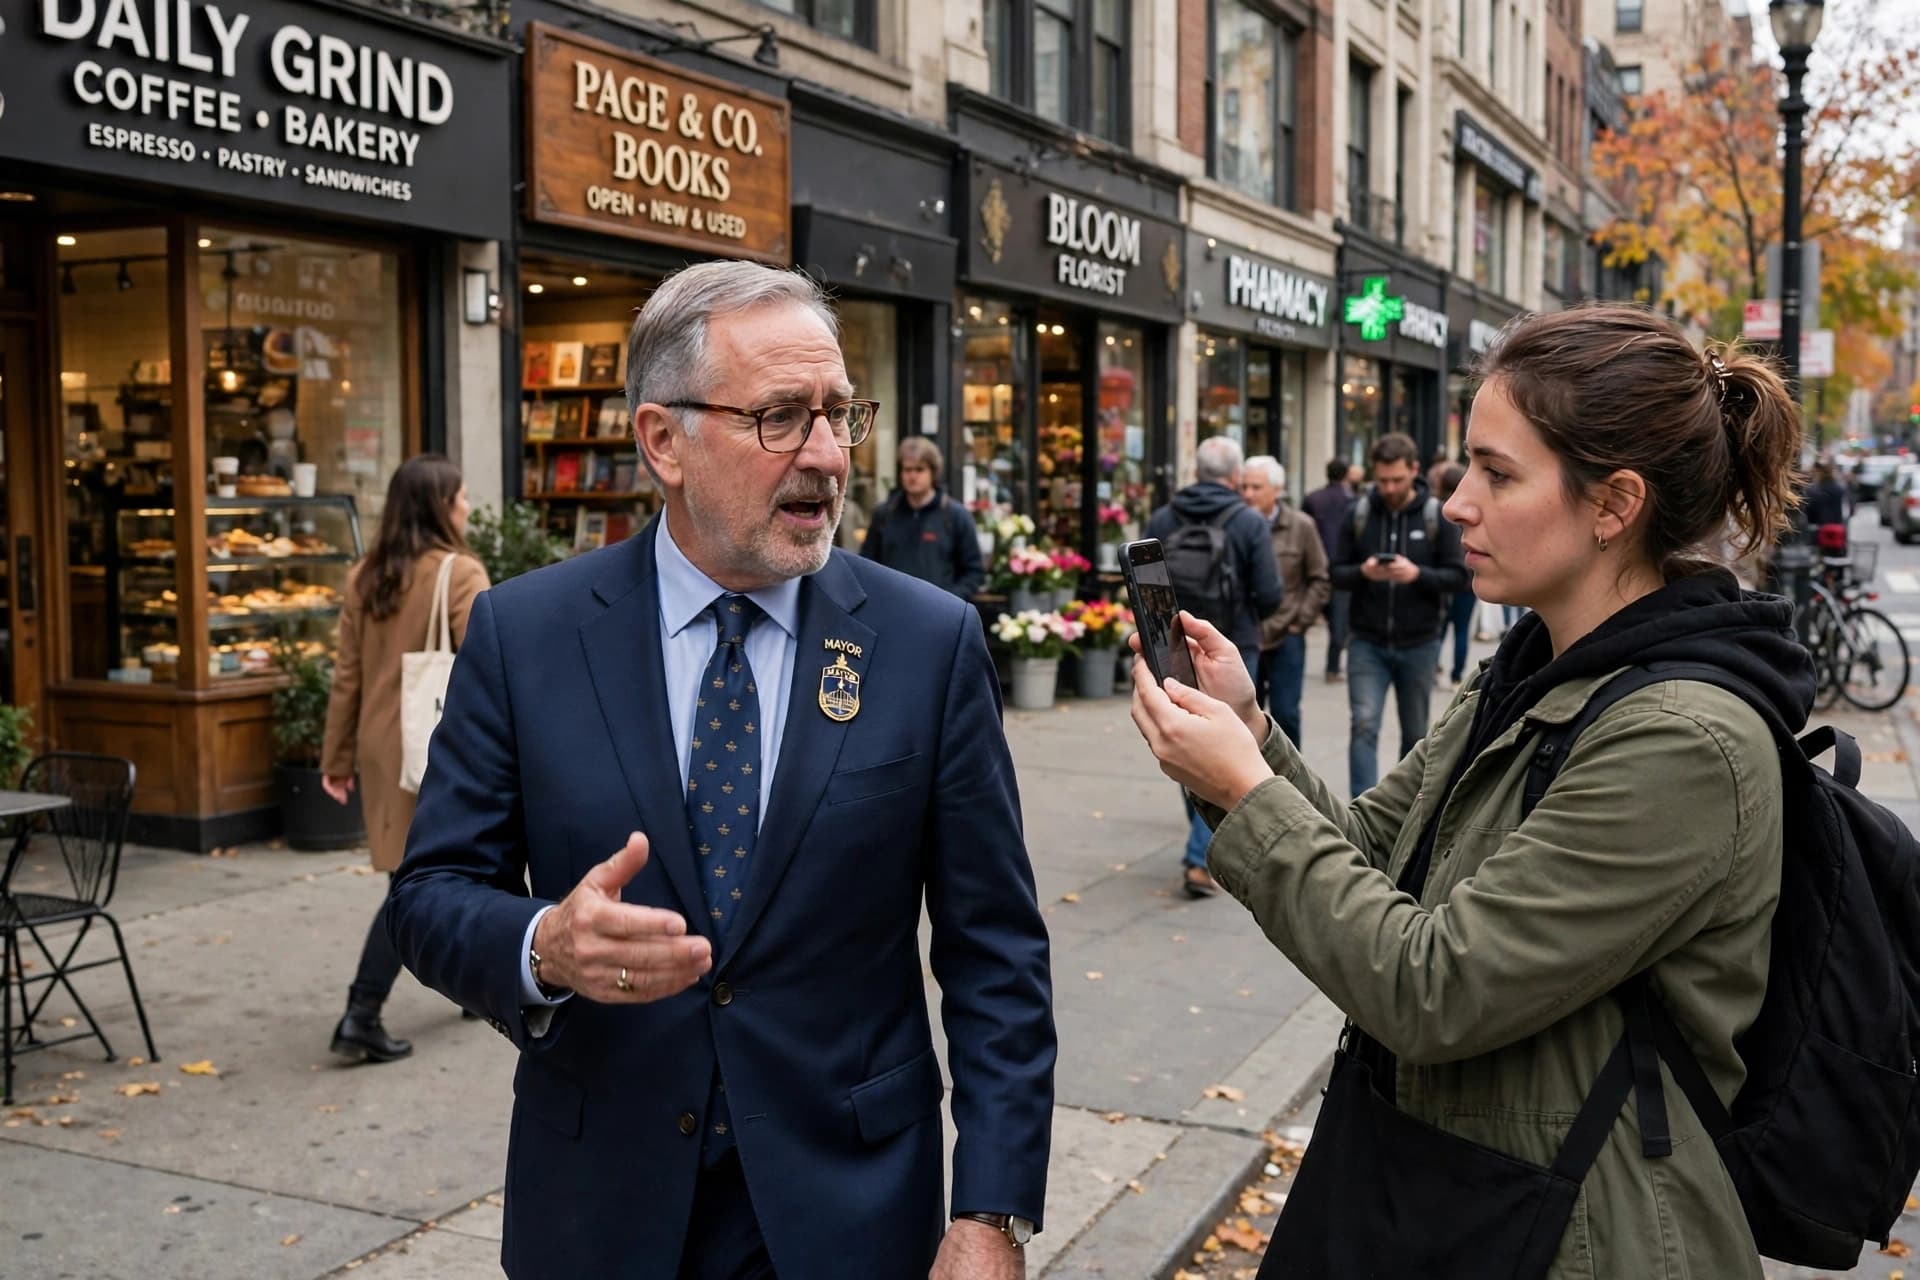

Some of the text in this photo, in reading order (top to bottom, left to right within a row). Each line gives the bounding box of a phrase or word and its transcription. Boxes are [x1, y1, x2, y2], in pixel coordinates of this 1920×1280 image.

[270, 25, 454, 125] GRIND
[574, 60, 763, 157] PAGE & CO.
[74, 60, 241, 133] COFFEE
[285, 105, 420, 167] BAKERY
[89, 123, 412, 201] ESPRESSO PASTRY SANDWICHES
[613, 131, 731, 201] BOOKS
[587, 185, 747, 239] OPEN NEW & USED
[1048, 192, 1141, 266] BLOOM
[1058, 254, 1126, 296] FLORIST
[1230, 254, 1328, 328] PHARMACY
[824, 638, 863, 658] MAYOR
